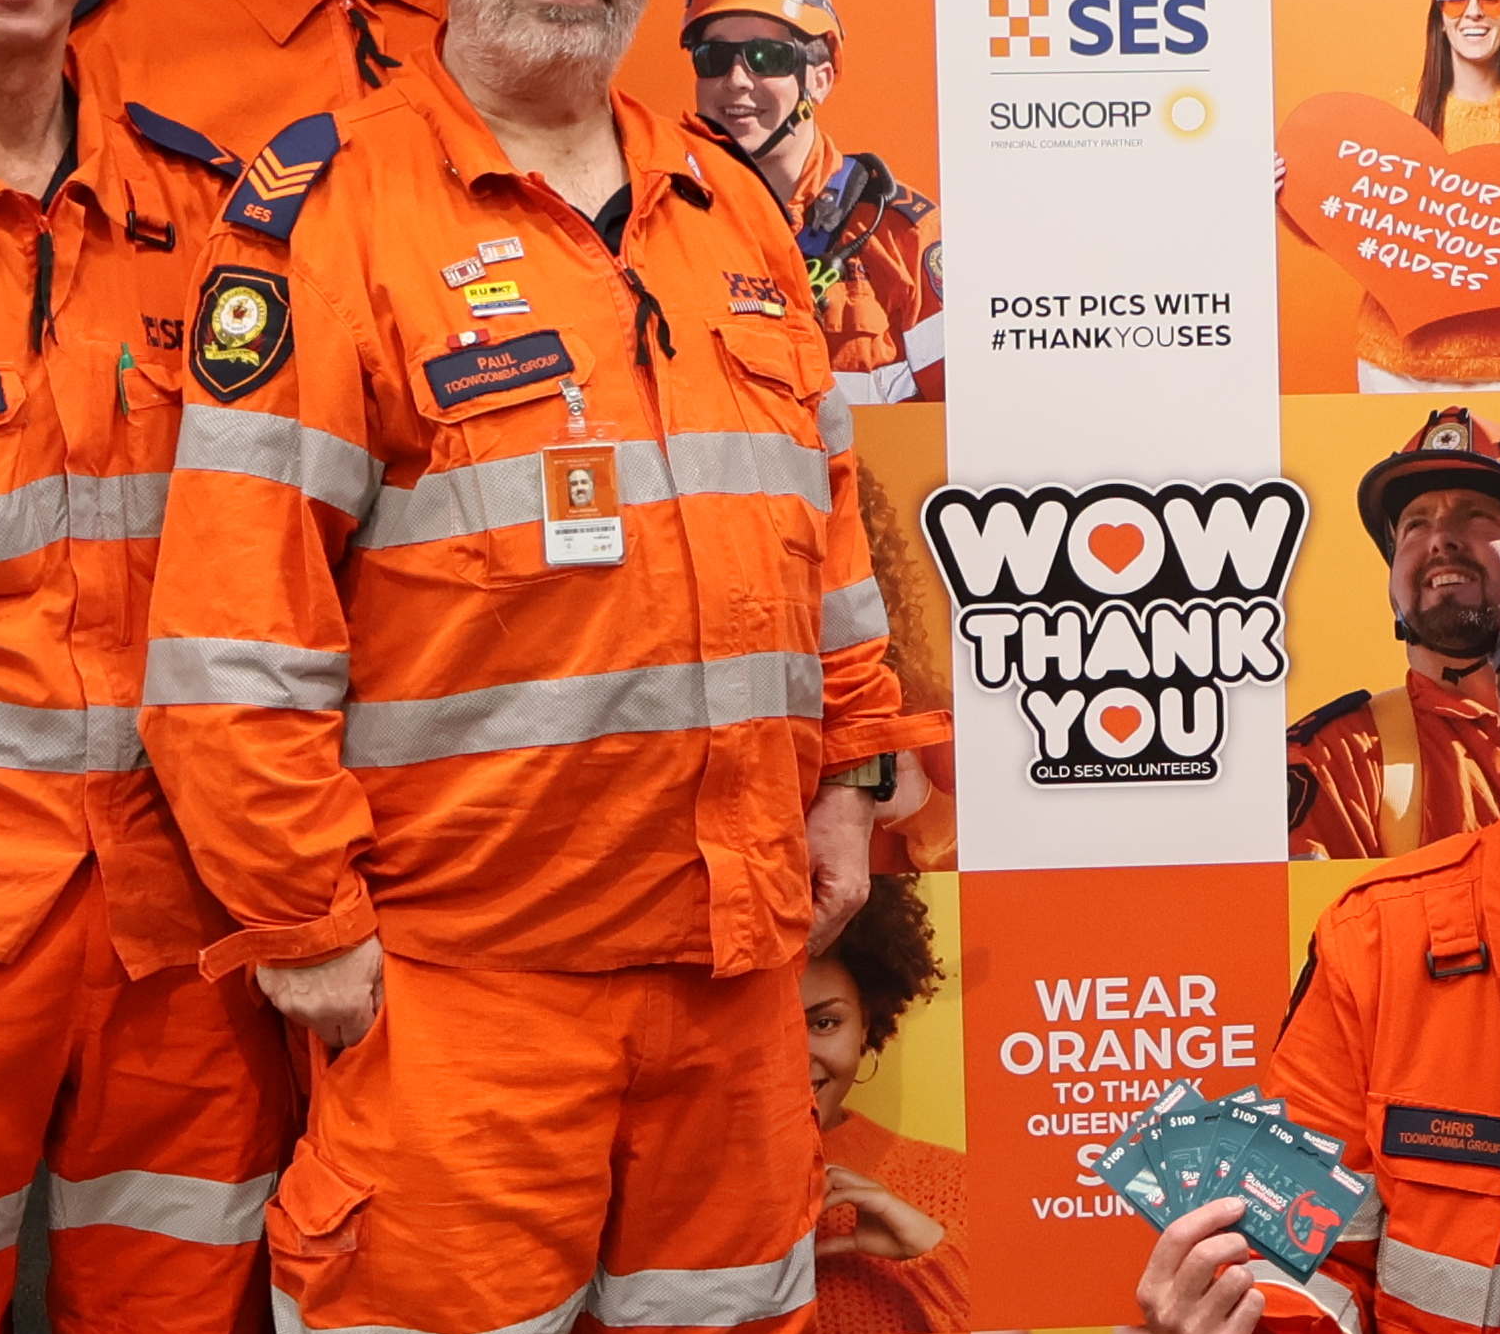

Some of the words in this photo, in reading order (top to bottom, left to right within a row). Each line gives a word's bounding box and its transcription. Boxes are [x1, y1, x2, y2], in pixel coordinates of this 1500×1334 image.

[990, 101, 1151, 130] SUNCORP
[991, 140, 1038, 149] PRINCIPAL
[1040, 139, 1099, 149] COMMUNITY
[1101, 138, 1143, 148] PARTNER
[1338, 140, 1421, 179] POST
[1352, 176, 1409, 204] AND
[243, 203, 273, 223] SES
[1357, 237, 1488, 290] #QLDSES
[990, 296, 1071, 318] POST
[1080, 294, 1146, 316] PICS
[1154, 293, 1231, 315] WITH
[991, 324, 1232, 350] #THANKYOUSES
[444, 367, 519, 395] TOOWOOMBA
[519, 353, 560, 374] GROUP
[477, 354, 517, 370] PAUL
[939, 495, 1291, 597] WOW
[966, 606, 1283, 683] THANK
[1026, 686, 1218, 759] YOU
[1036, 764, 1071, 779] QLD
[1074, 763, 1104, 777] SES
[1105, 761, 1211, 777] VOLUNTEERS
[1034, 974, 1217, 1022] WEAR
[1000, 1024, 1257, 1075] ORANGE
[1052, 1081, 1095, 1104] TO
[1170, 1115, 1195, 1127] $100
[1231, 1107, 1257, 1124] $100
[1430, 1118, 1474, 1137] CHRIS
[1269, 1124, 1293, 1144] $100
[1399, 1132, 1466, 1151] TOOWOOMBA
[1102, 1147, 1125, 1169] $100
